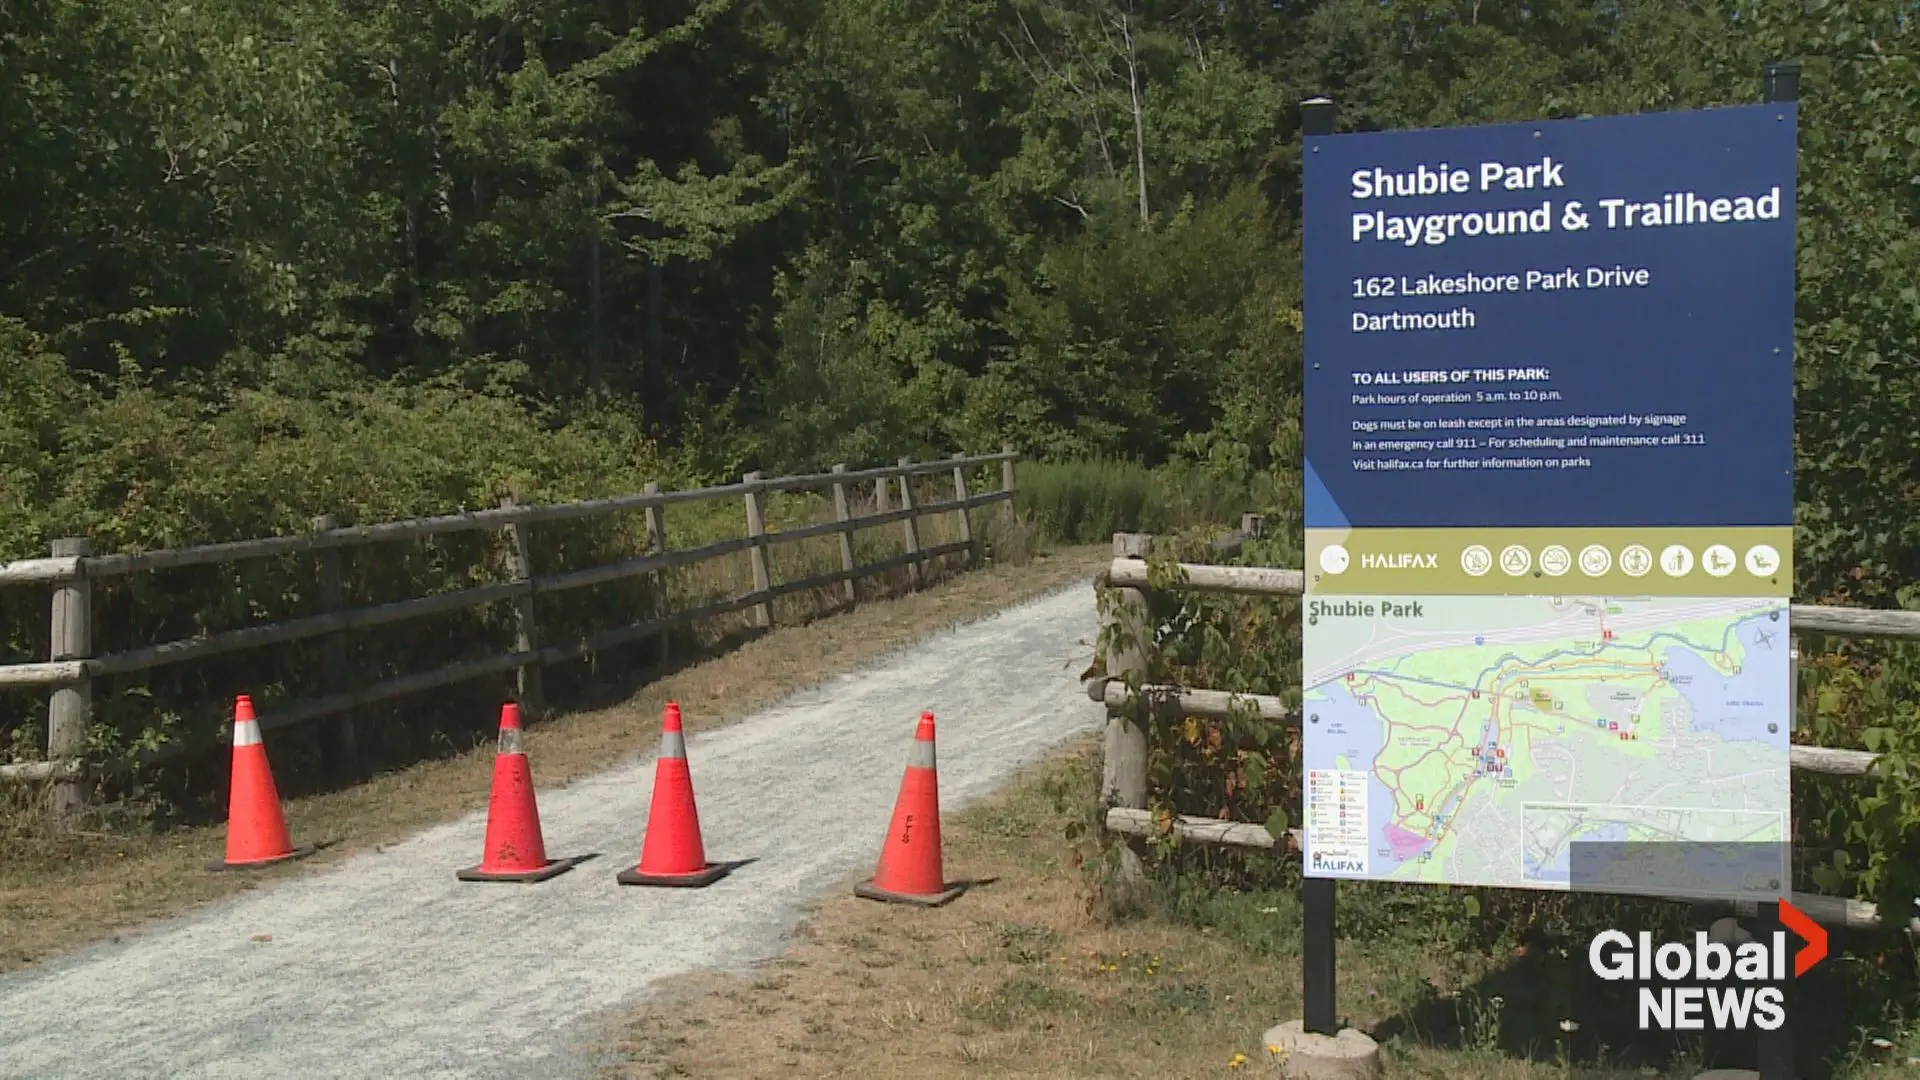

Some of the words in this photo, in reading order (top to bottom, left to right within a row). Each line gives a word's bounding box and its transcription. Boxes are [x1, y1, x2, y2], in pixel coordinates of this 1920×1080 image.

[1351, 163, 1470, 199] Shubie
[1480, 157, 1564, 192] Park
[1352, 201, 1551, 246] Playground
[1561, 201, 1589, 231] &
[1600, 187, 1781, 228] Trailhead
[1352, 276, 1395, 298] 162
[1401, 272, 1519, 296] Lakeshore
[1526, 268, 1580, 292] Park
[1586, 265, 1650, 288] Drive
[1352, 308, 1476, 332] Dartmouth
[1352, 373, 1371, 385] TO
[1374, 372, 1400, 384] ALL
[1403, 370, 1448, 383] USERS
[1450, 370, 1470, 382] OF
[1473, 369, 1505, 381] THIS
[1508, 368, 1550, 380] PARK:
[1352, 394, 1376, 405] Park
[1377, 393, 1406, 404] hours
[1408, 392, 1419, 403] of
[1421, 392, 1471, 405] operation
[1476, 391, 1483, 402] 5
[1485, 392, 1507, 401] a.m.
[1509, 391, 1521, 401] to
[1523, 390, 1538, 400] 10
[1540, 390, 1562, 402] p.m.
[1352, 420, 1378, 432] Dogs
[1380, 420, 1406, 430] must
[1408, 418, 1421, 429] be
[1423, 420, 1437, 429] on
[1439, 418, 1465, 429] leash
[1468, 417, 1502, 430] except
[1504, 417, 1514, 427] in
[1516, 416, 1534, 427] the
[1536, 417, 1565, 427] areas
[1567, 414, 1627, 428] designated
[1629, 413, 1642, 426] by
[1644, 413, 1686, 426] signage
[1352, 440, 1362, 450] In
[1364, 441, 1376, 450] an
[1378, 440, 1434, 452] emergency
[1436, 438, 1453, 448] call
[1456, 438, 1476, 448] 911
[1488, 437, 1505, 448] For
[1508, 436, 1565, 449] scheduling
[1567, 435, 1587, 447] and
[1589, 434, 1659, 446] maintenance
[1661, 433, 1680, 444] call
[1682, 433, 1705, 444] 311
[1352, 459, 1375, 470] Visit
[1377, 457, 1423, 469] halifax.ca
[1426, 457, 1439, 469] for
[1443, 456, 1479, 468] further
[1482, 456, 1543, 468] information
[1545, 457, 1559, 467] on
[1561, 455, 1591, 469] parks
[1361, 552, 1439, 569] HALIFAX
[1309, 600, 1375, 617] Shubie
[1381, 600, 1424, 617] Park
[1312, 860, 1364, 872] HALIFAX
